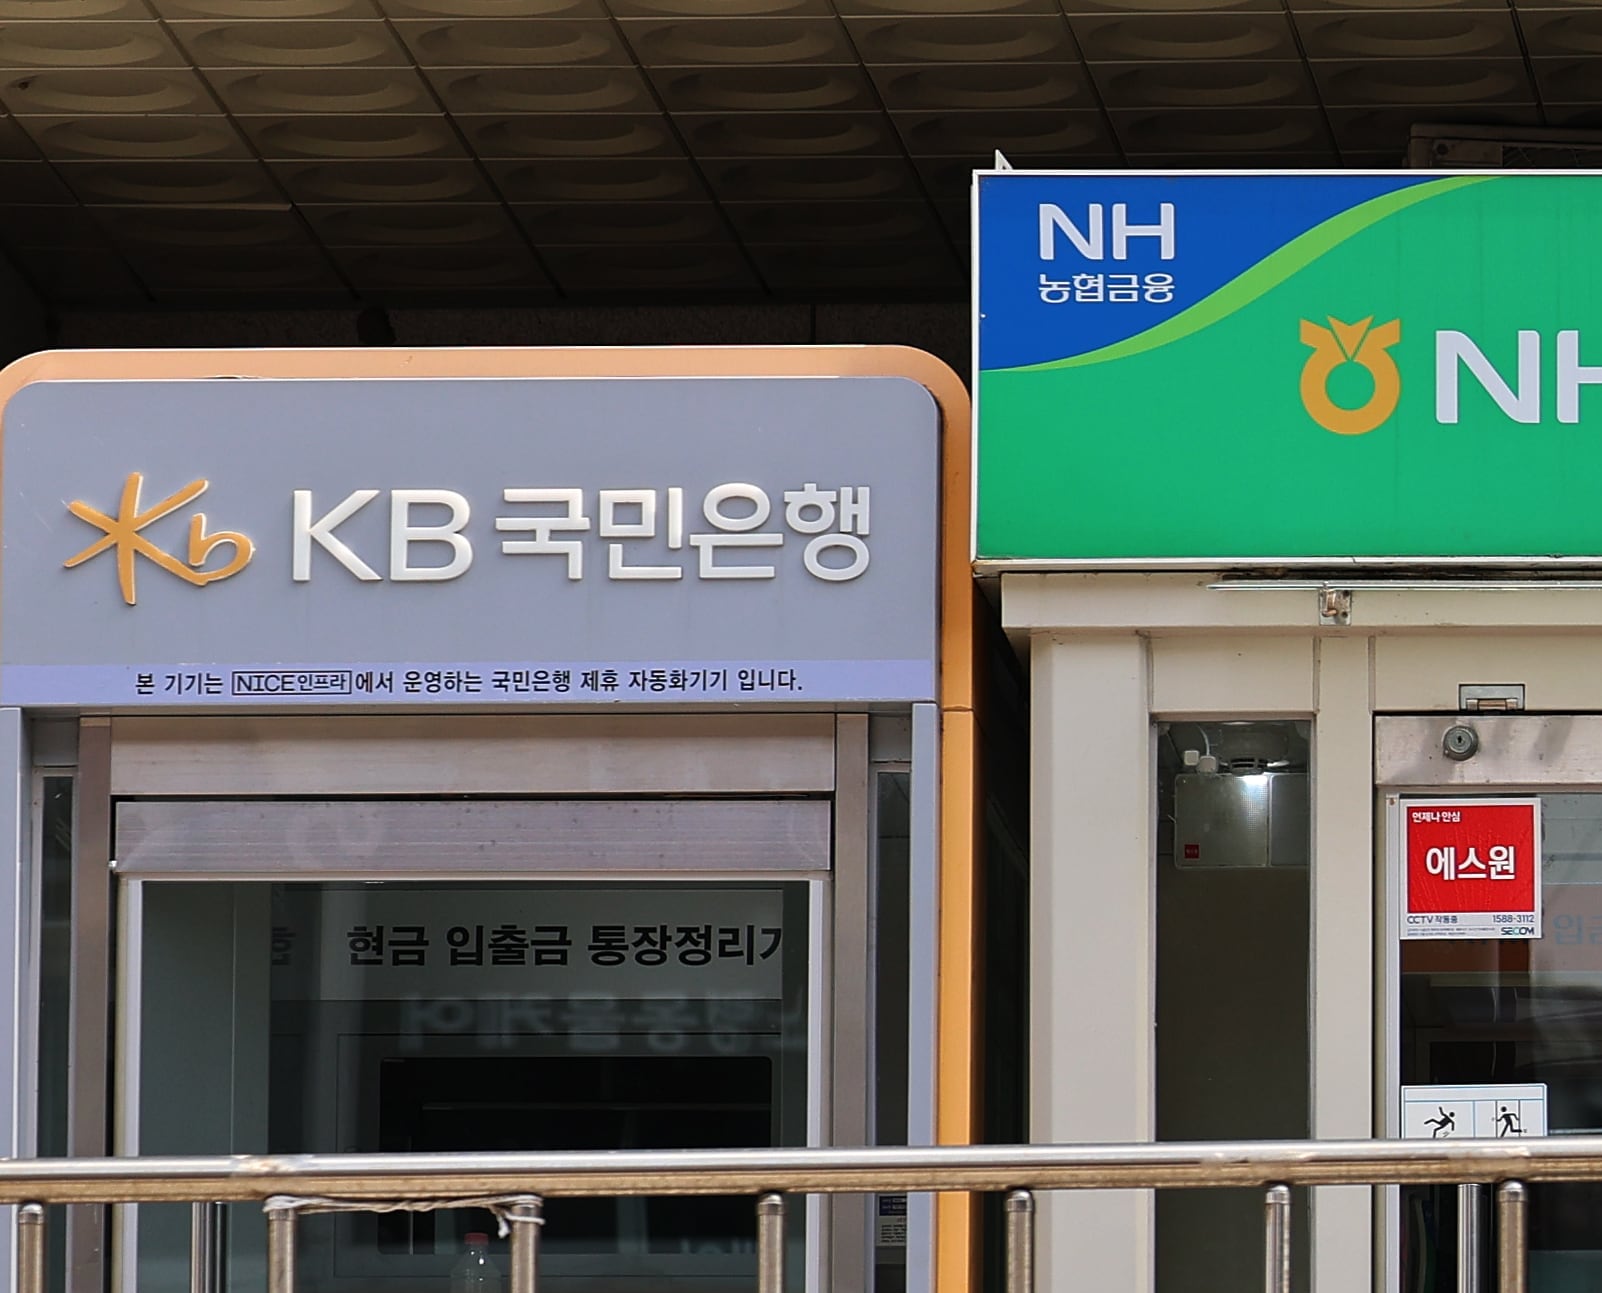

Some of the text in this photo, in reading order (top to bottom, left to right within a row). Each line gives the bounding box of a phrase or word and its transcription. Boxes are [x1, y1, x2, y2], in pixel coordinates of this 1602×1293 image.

[1039, 203, 1175, 261] NH
[1038, 272, 1176, 305] 농협금융
[135, 672, 155, 694] 본
[165, 672, 223, 695] 기기는
[403, 671, 483, 694] 운영하는
[491, 670, 571, 692] 국민은행
[580, 670, 619, 692] 제휴
[628, 669, 728, 691] 자동화기기
[738, 669, 803, 691] 입니다.
[1442, 811, 1461, 822] 안심
[1425, 846, 1515, 880] 에스원
[1407, 916, 1433, 924] CCTV
[1492, 915, 1535, 923] 1588-3112
[347, 924, 430, 966] 현금
[447, 924, 572, 966] 입출금
